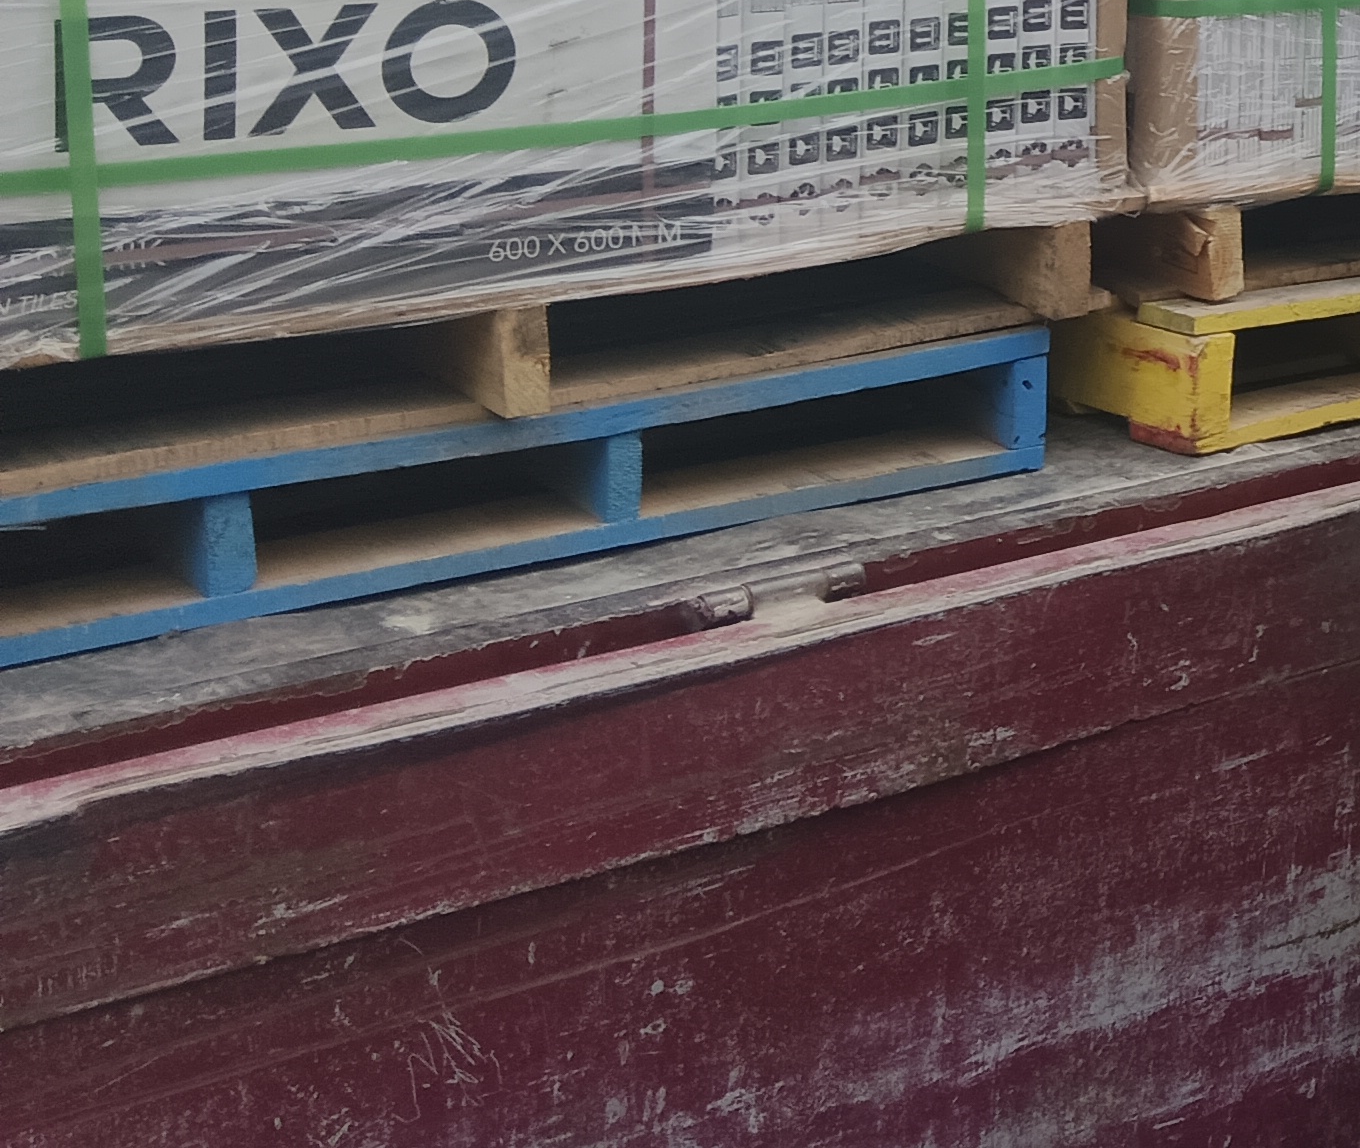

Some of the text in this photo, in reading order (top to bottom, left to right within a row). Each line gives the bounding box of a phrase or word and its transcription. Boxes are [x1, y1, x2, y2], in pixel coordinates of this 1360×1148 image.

[489, 236, 540, 262] 600
[547, 234, 566, 256] X
[574, 227, 624, 252] 600
